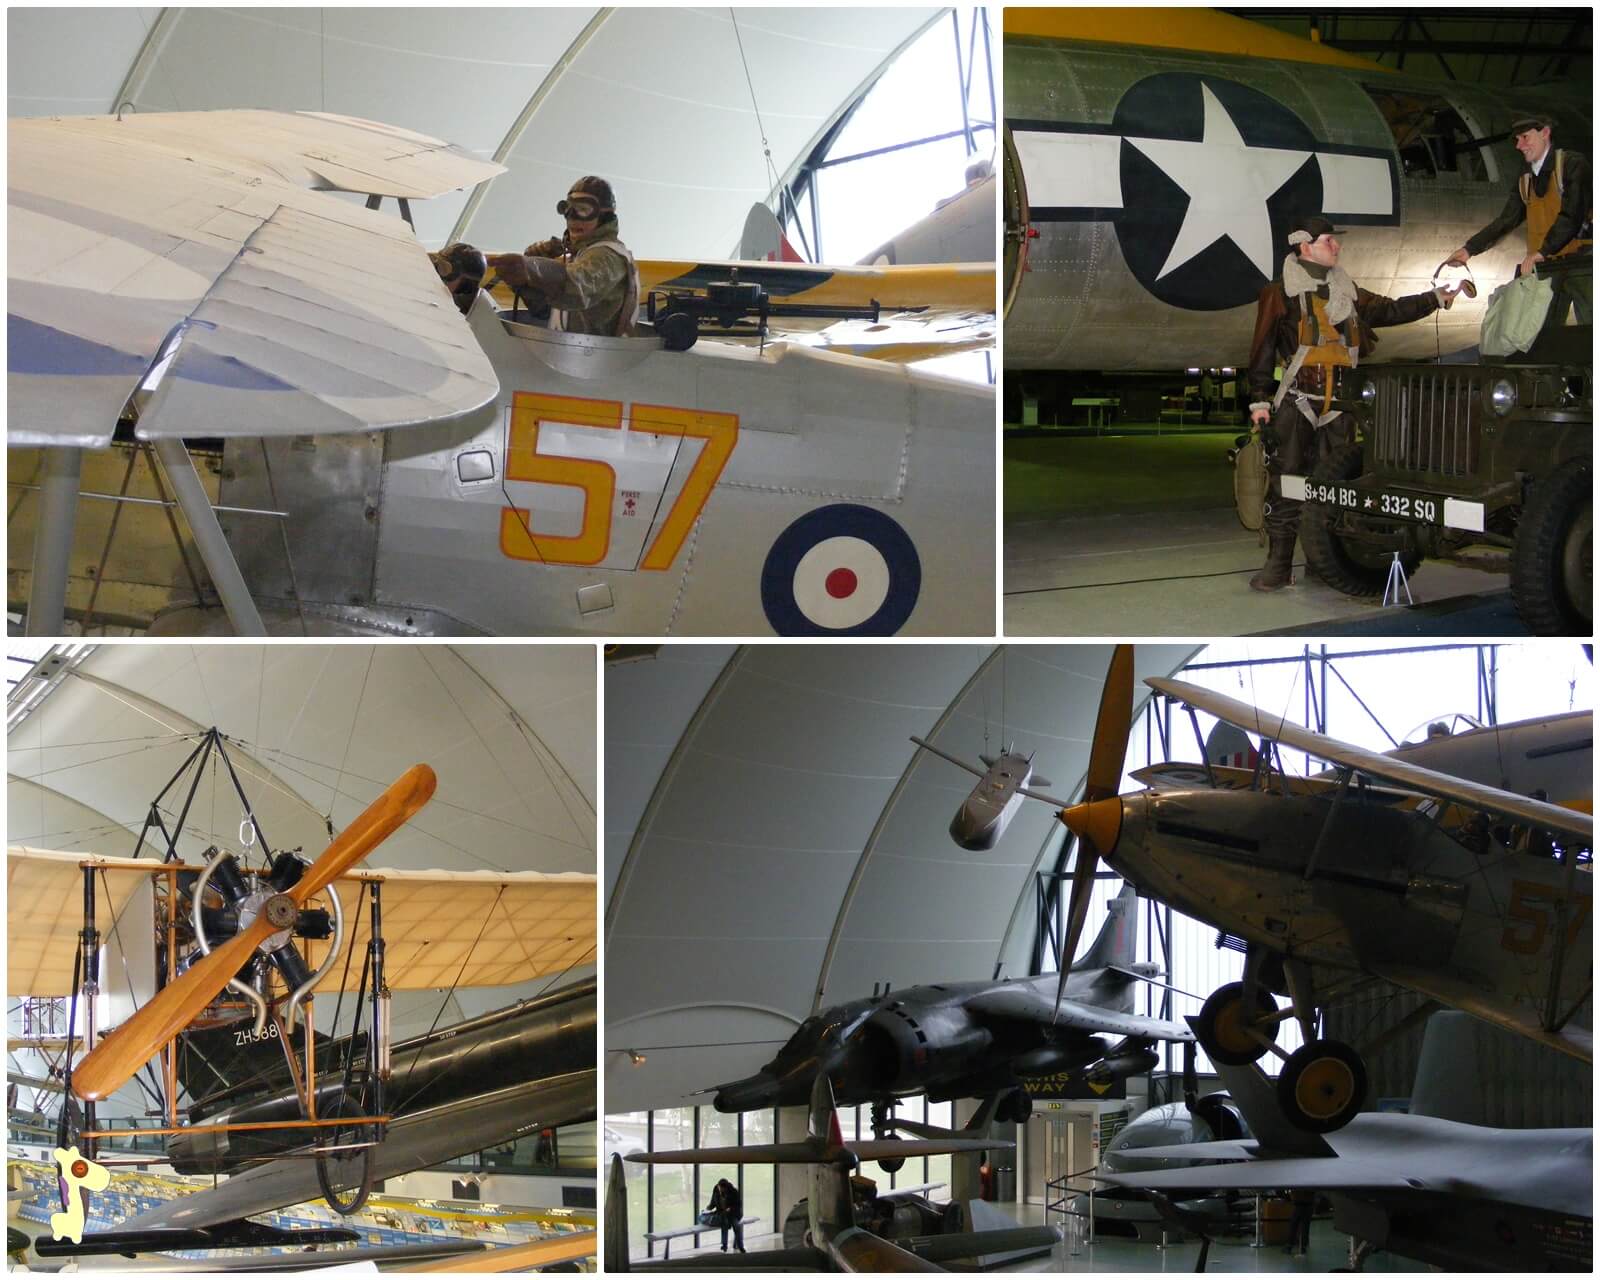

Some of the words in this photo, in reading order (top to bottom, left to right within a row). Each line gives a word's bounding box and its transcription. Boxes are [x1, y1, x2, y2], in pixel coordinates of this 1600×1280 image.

[500, 390, 740, 571] 57
[621, 490, 640, 498] FIRST
[1380, 494, 1410, 516] 332
[1414, 499, 1435, 522] SQ
[1023, 1082, 1066, 1093] WAY
